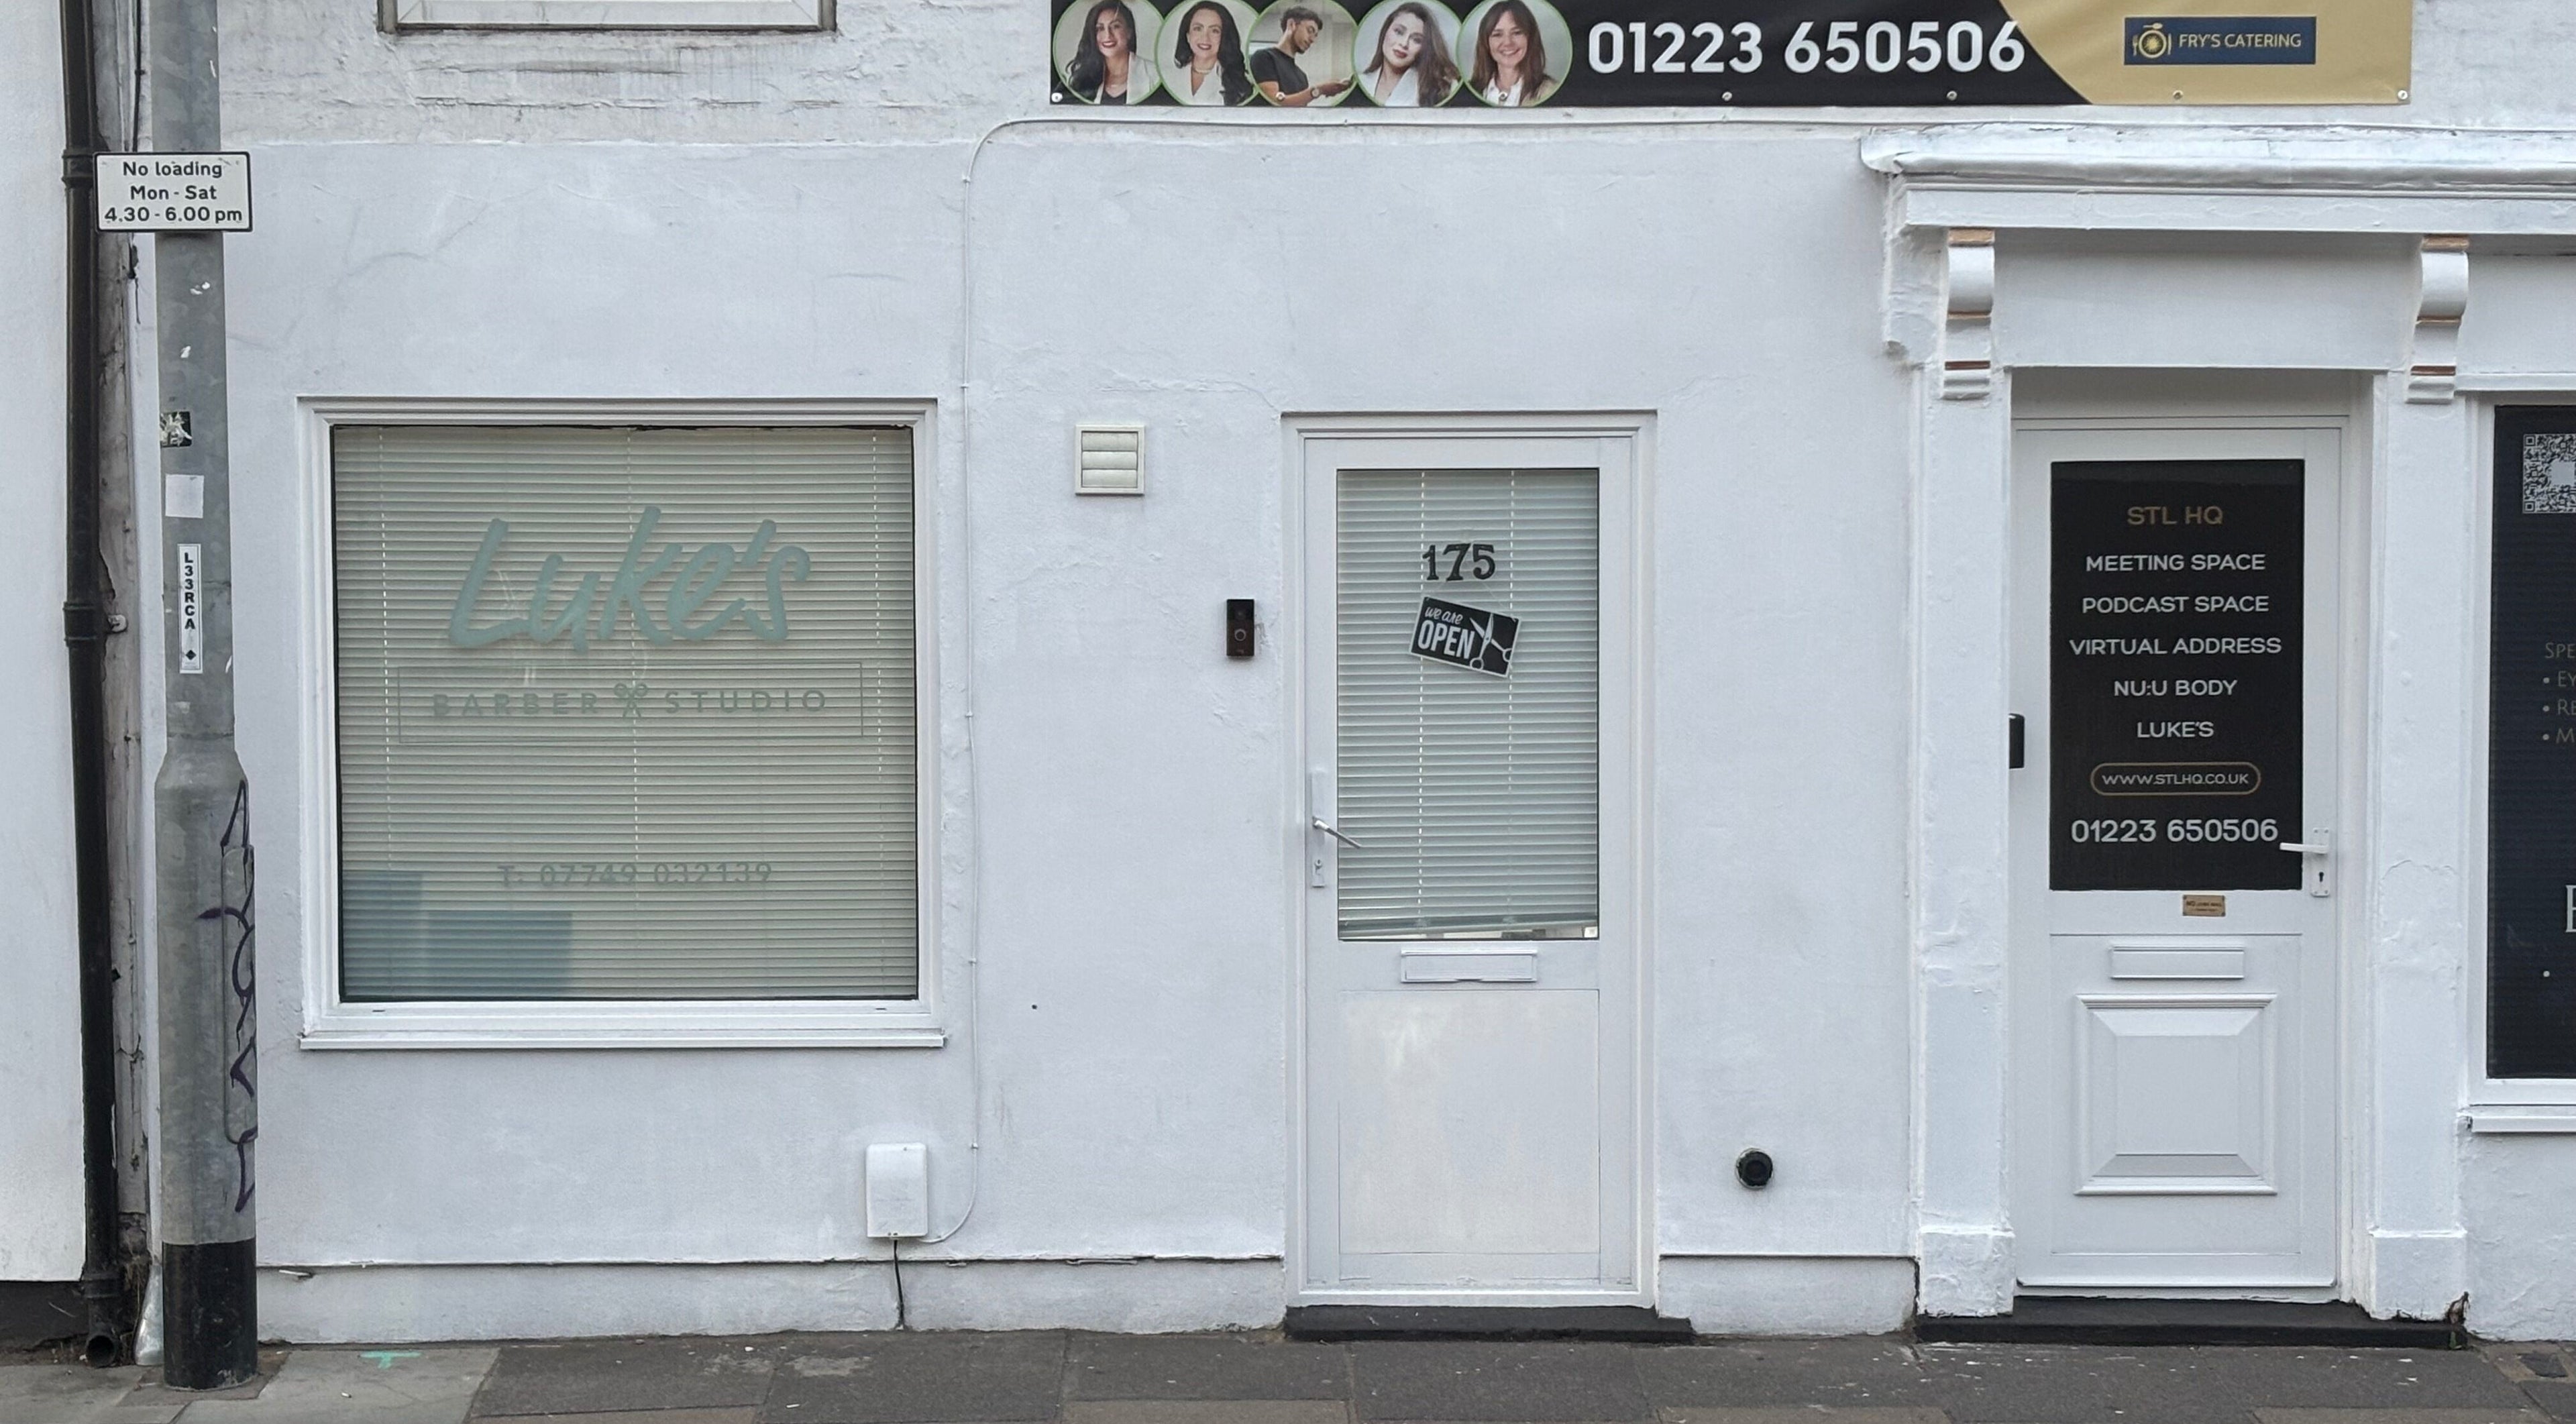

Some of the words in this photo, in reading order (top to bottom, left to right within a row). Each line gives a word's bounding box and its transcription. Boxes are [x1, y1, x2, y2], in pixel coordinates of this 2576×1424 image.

[1588, 21, 1762, 73] 01223
[1784, 21, 2025, 73] 650506
[2179, 34, 2221, 48] FRY'S
[2224, 34, 2302, 48] CATERING
[123, 162, 149, 176] No
[156, 161, 223, 178] loading
[130, 186, 169, 200] Mon
[184, 185, 217, 200] Sat
[104, 207, 150, 222] 4.30
[165, 207, 210, 222] 6.00
[215, 210, 243, 223] pm
[2127, 506, 2177, 525] STL
[2186, 506, 2223, 525] HQ
[1422, 543, 1495, 581] 175
[2086, 555, 2184, 571] MEETING
[2191, 554, 2266, 570] SPACE
[449, 506, 812, 653] Luke's
[2082, 597, 2189, 613] PODCAST
[2194, 596, 2269, 612] SPACE
[1425, 607, 1442, 619] we
[1442, 611, 1463, 624] are
[1417, 620, 1475, 659] OPEN
[2069, 639, 2167, 655] VIRTUAL
[2172, 638, 2282, 654] ADDRESS
[2114, 680, 2167, 696] NU:U
[2176, 679, 2237, 696] BODY
[433, 692, 598, 716] BARBER
[665, 690, 826, 714] STUDIO
[2137, 722, 2214, 738] LUKE'S
[2102, 773, 2249, 785] WWW.STLHQ.CO.UK
[2072, 820, 2157, 842] 01223
[2167, 819, 2278, 842] 650506
[540, 863, 637, 887] 07749
[654, 863, 771, 886] 032139
